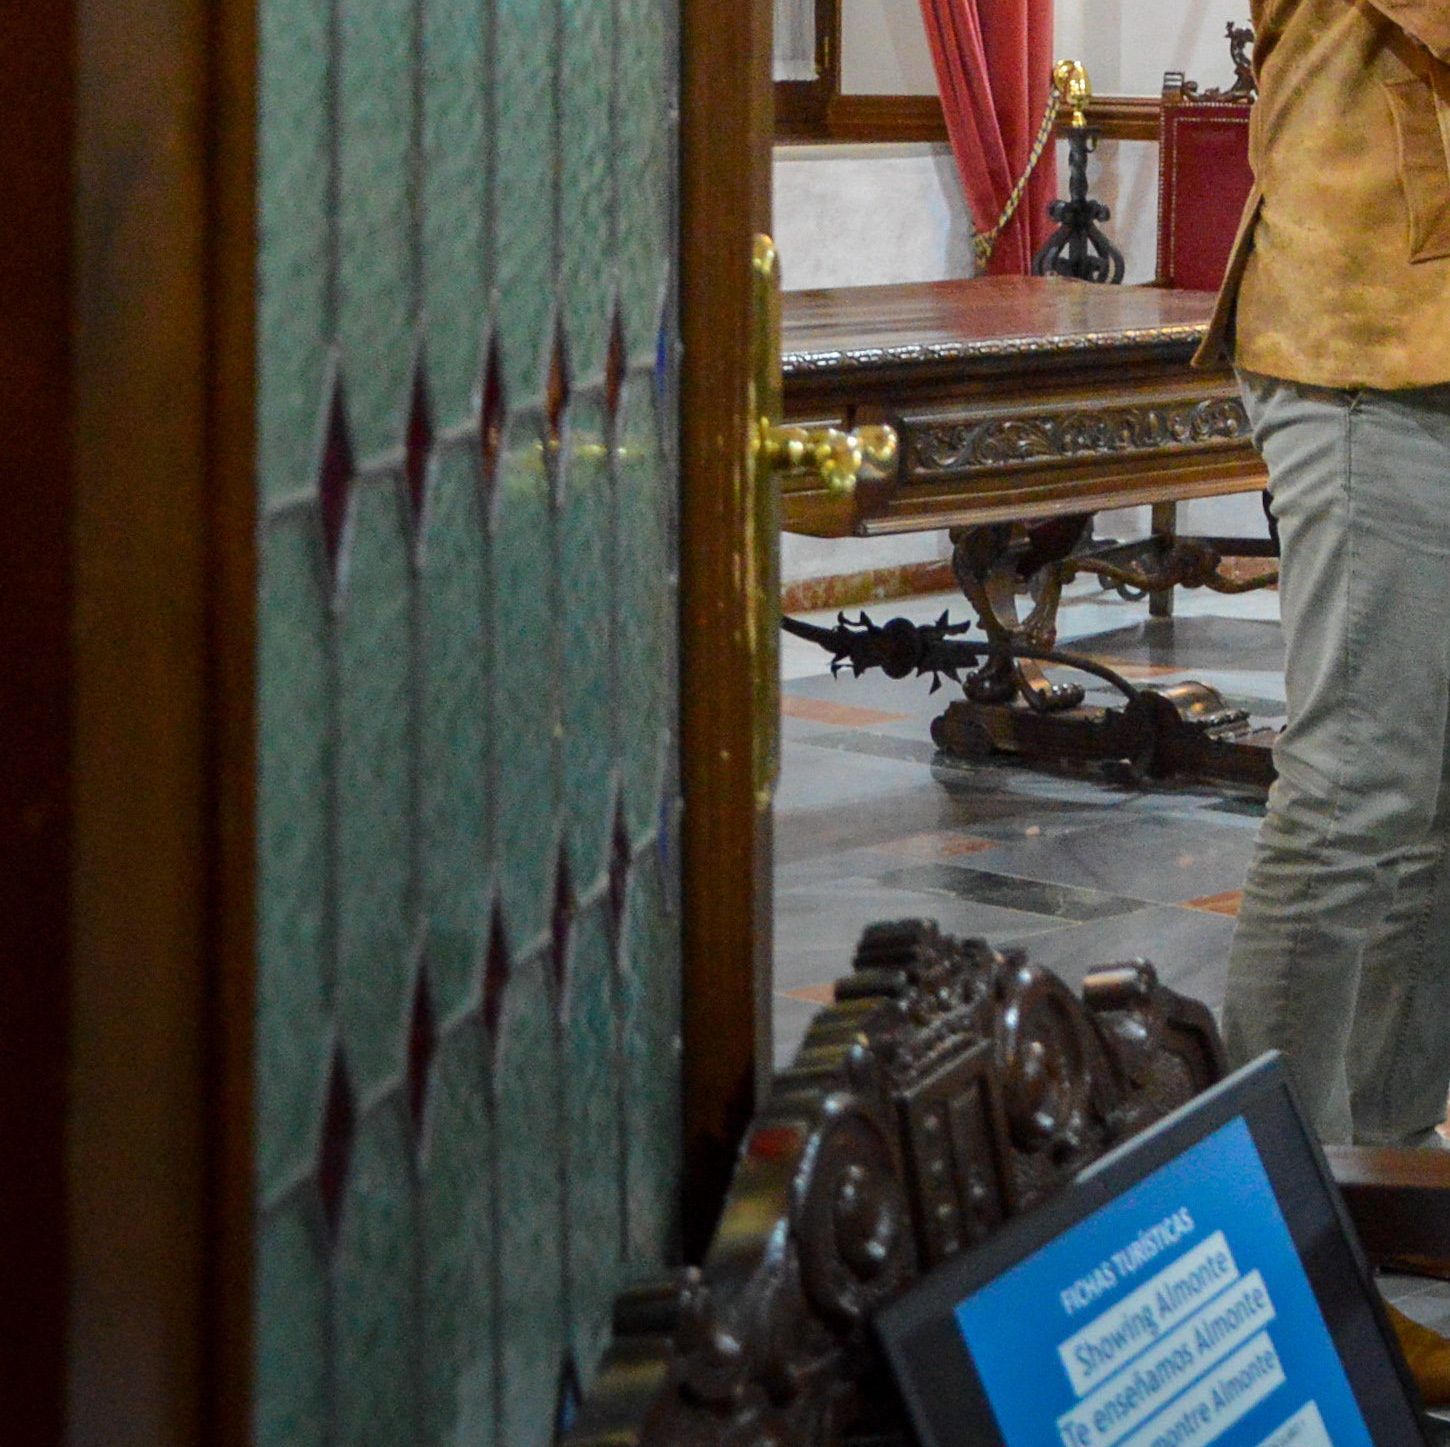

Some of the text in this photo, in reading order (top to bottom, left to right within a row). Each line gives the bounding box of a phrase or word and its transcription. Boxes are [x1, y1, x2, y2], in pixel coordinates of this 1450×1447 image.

[1060, 1206, 1195, 1316] FICHAS TURÍSTICAS
[1073, 1250, 1230, 1378] Showing Almonte
[1062, 1419, 1091, 1447] Te
[1094, 1342, 1195, 1433] enseñamos
[1194, 1286, 1264, 1352] Almonte
[1210, 1348, 1276, 1409] Almonte
